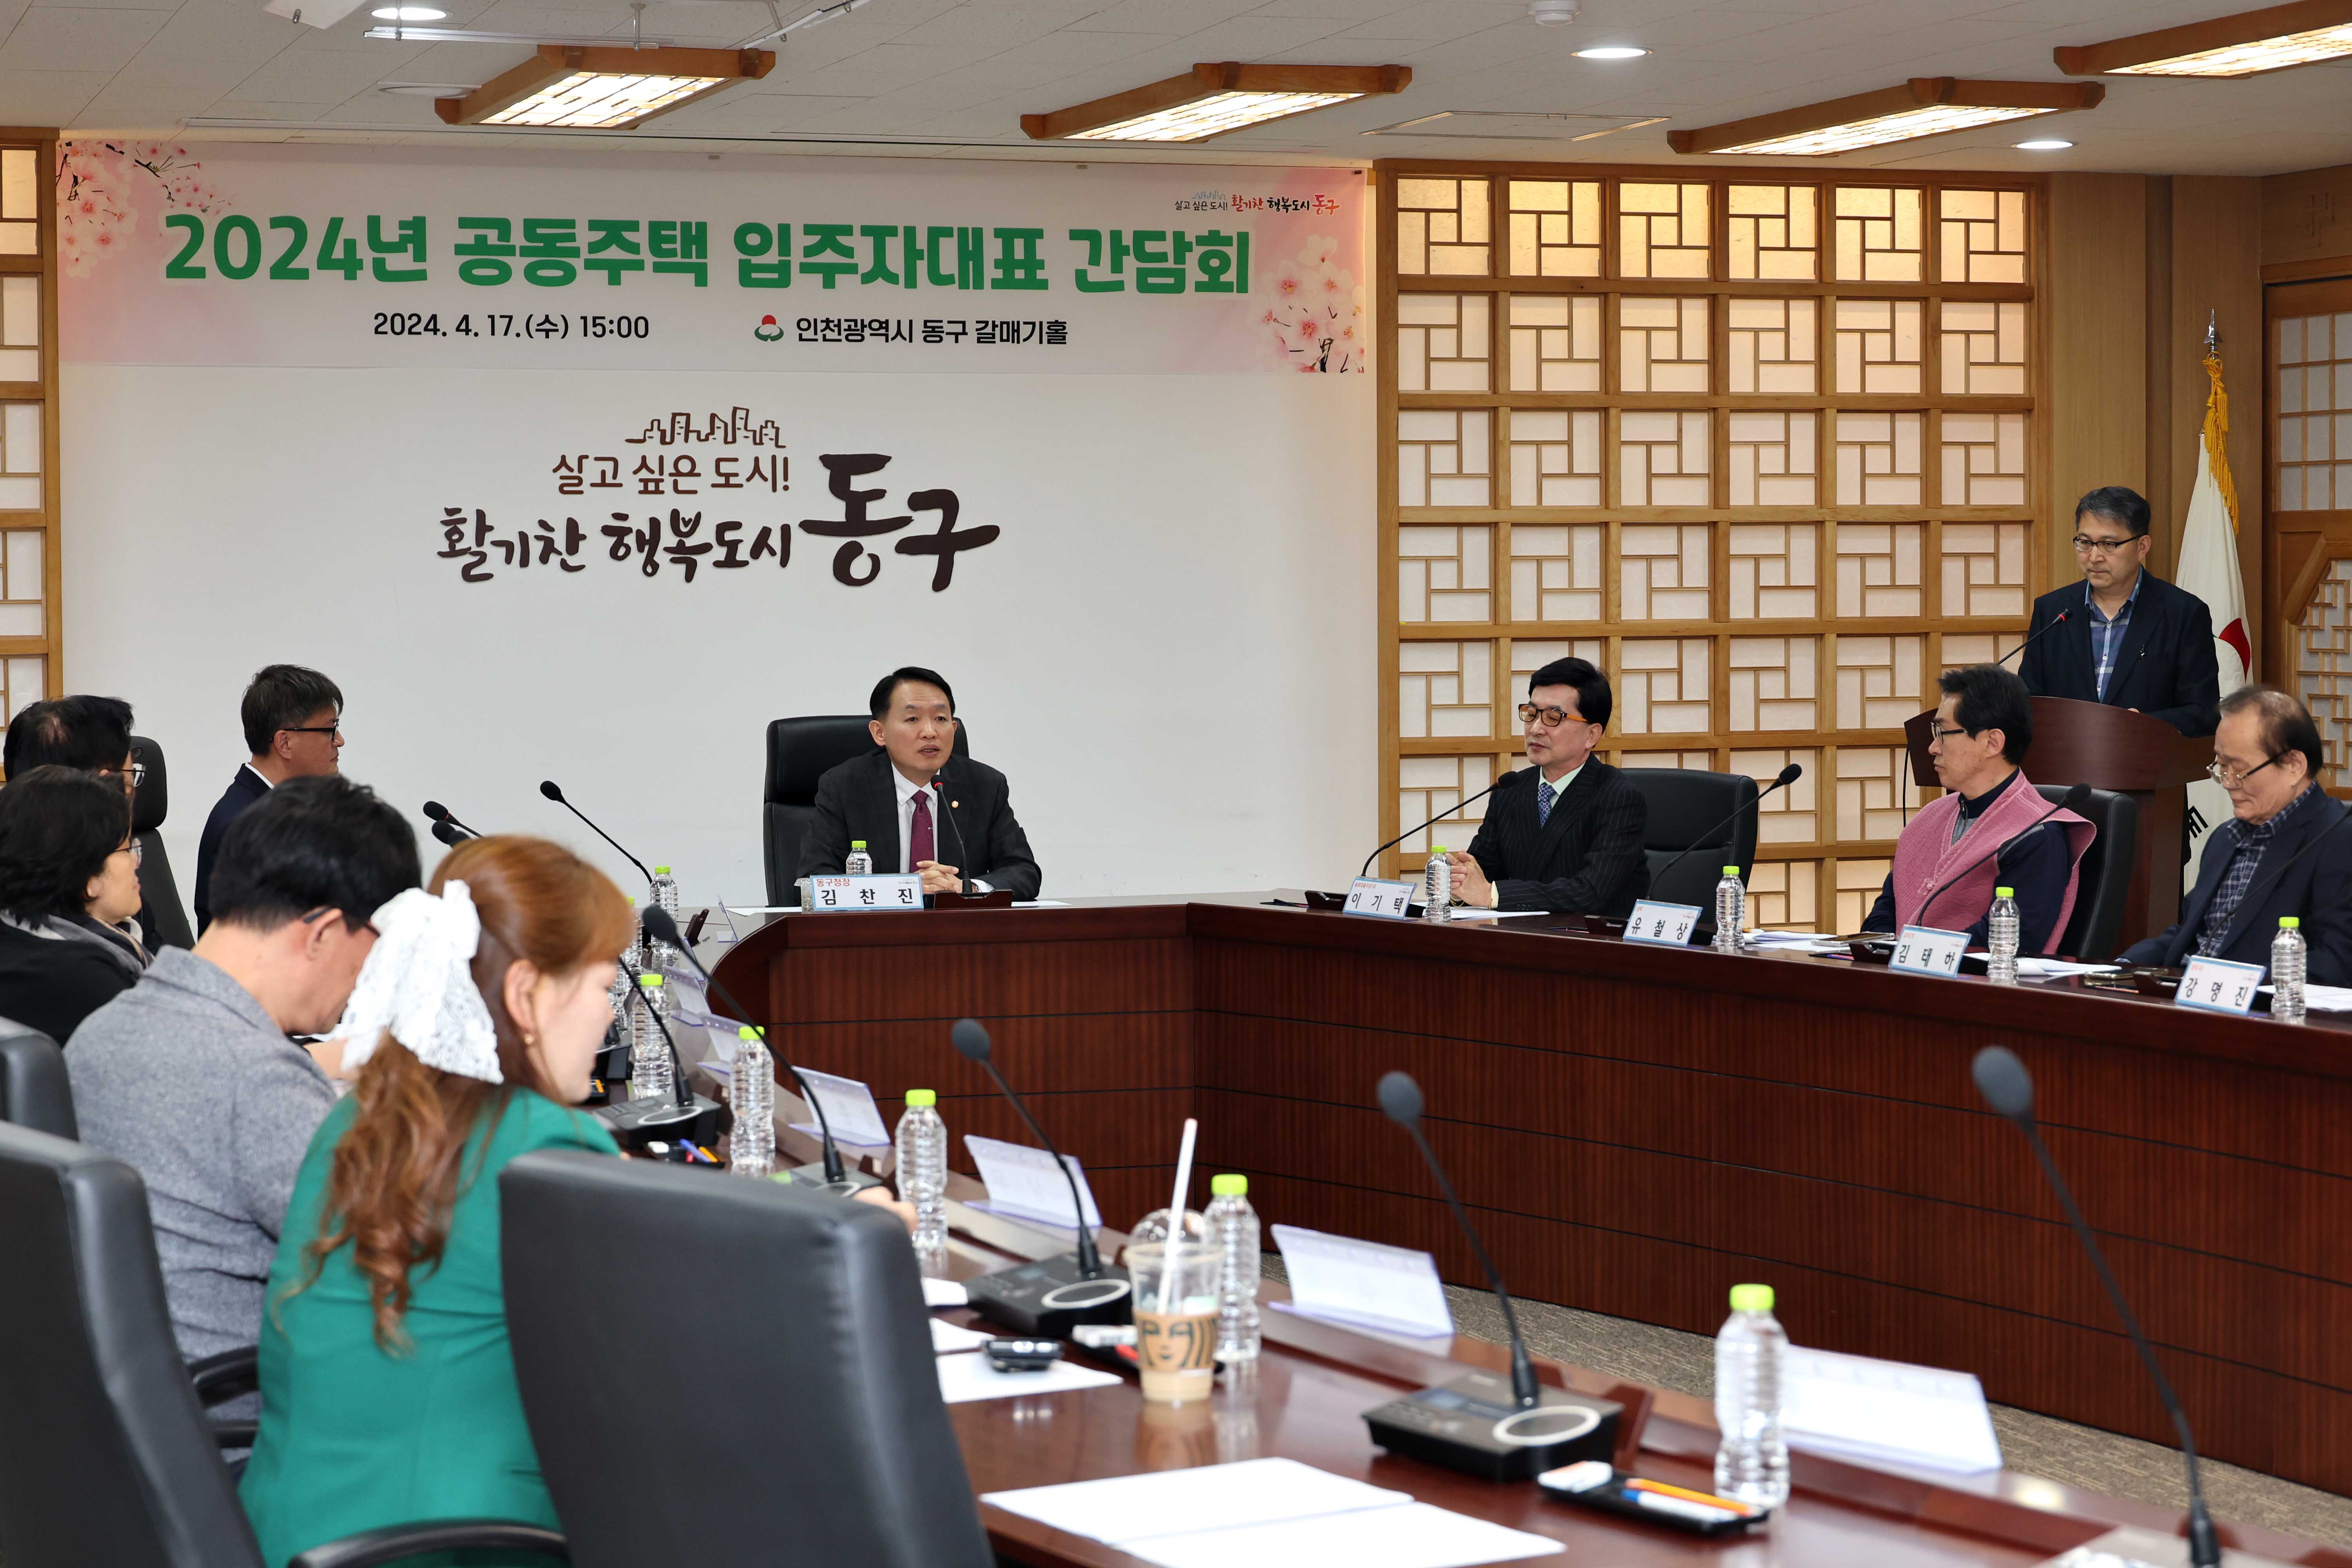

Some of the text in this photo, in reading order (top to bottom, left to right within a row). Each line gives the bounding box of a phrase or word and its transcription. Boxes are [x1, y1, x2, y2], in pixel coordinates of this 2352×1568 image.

[1175, 194, 1341, 215] 살고 싶은 도시! 활기찬 행복도시 동구
[165, 214, 1250, 294] 2024년 공동주택 입주자대표 간담회
[374, 313, 649, 339] 2024. 4. 17.(수) 15:00
[796, 318, 1068, 345] 인천광역시 동구 갈매기홀
[552, 454, 790, 495] 살고 싶은 도시!
[436, 453, 1001, 593] 활기찬 행복도시 동구
[816, 878, 850, 887] 동구청장
